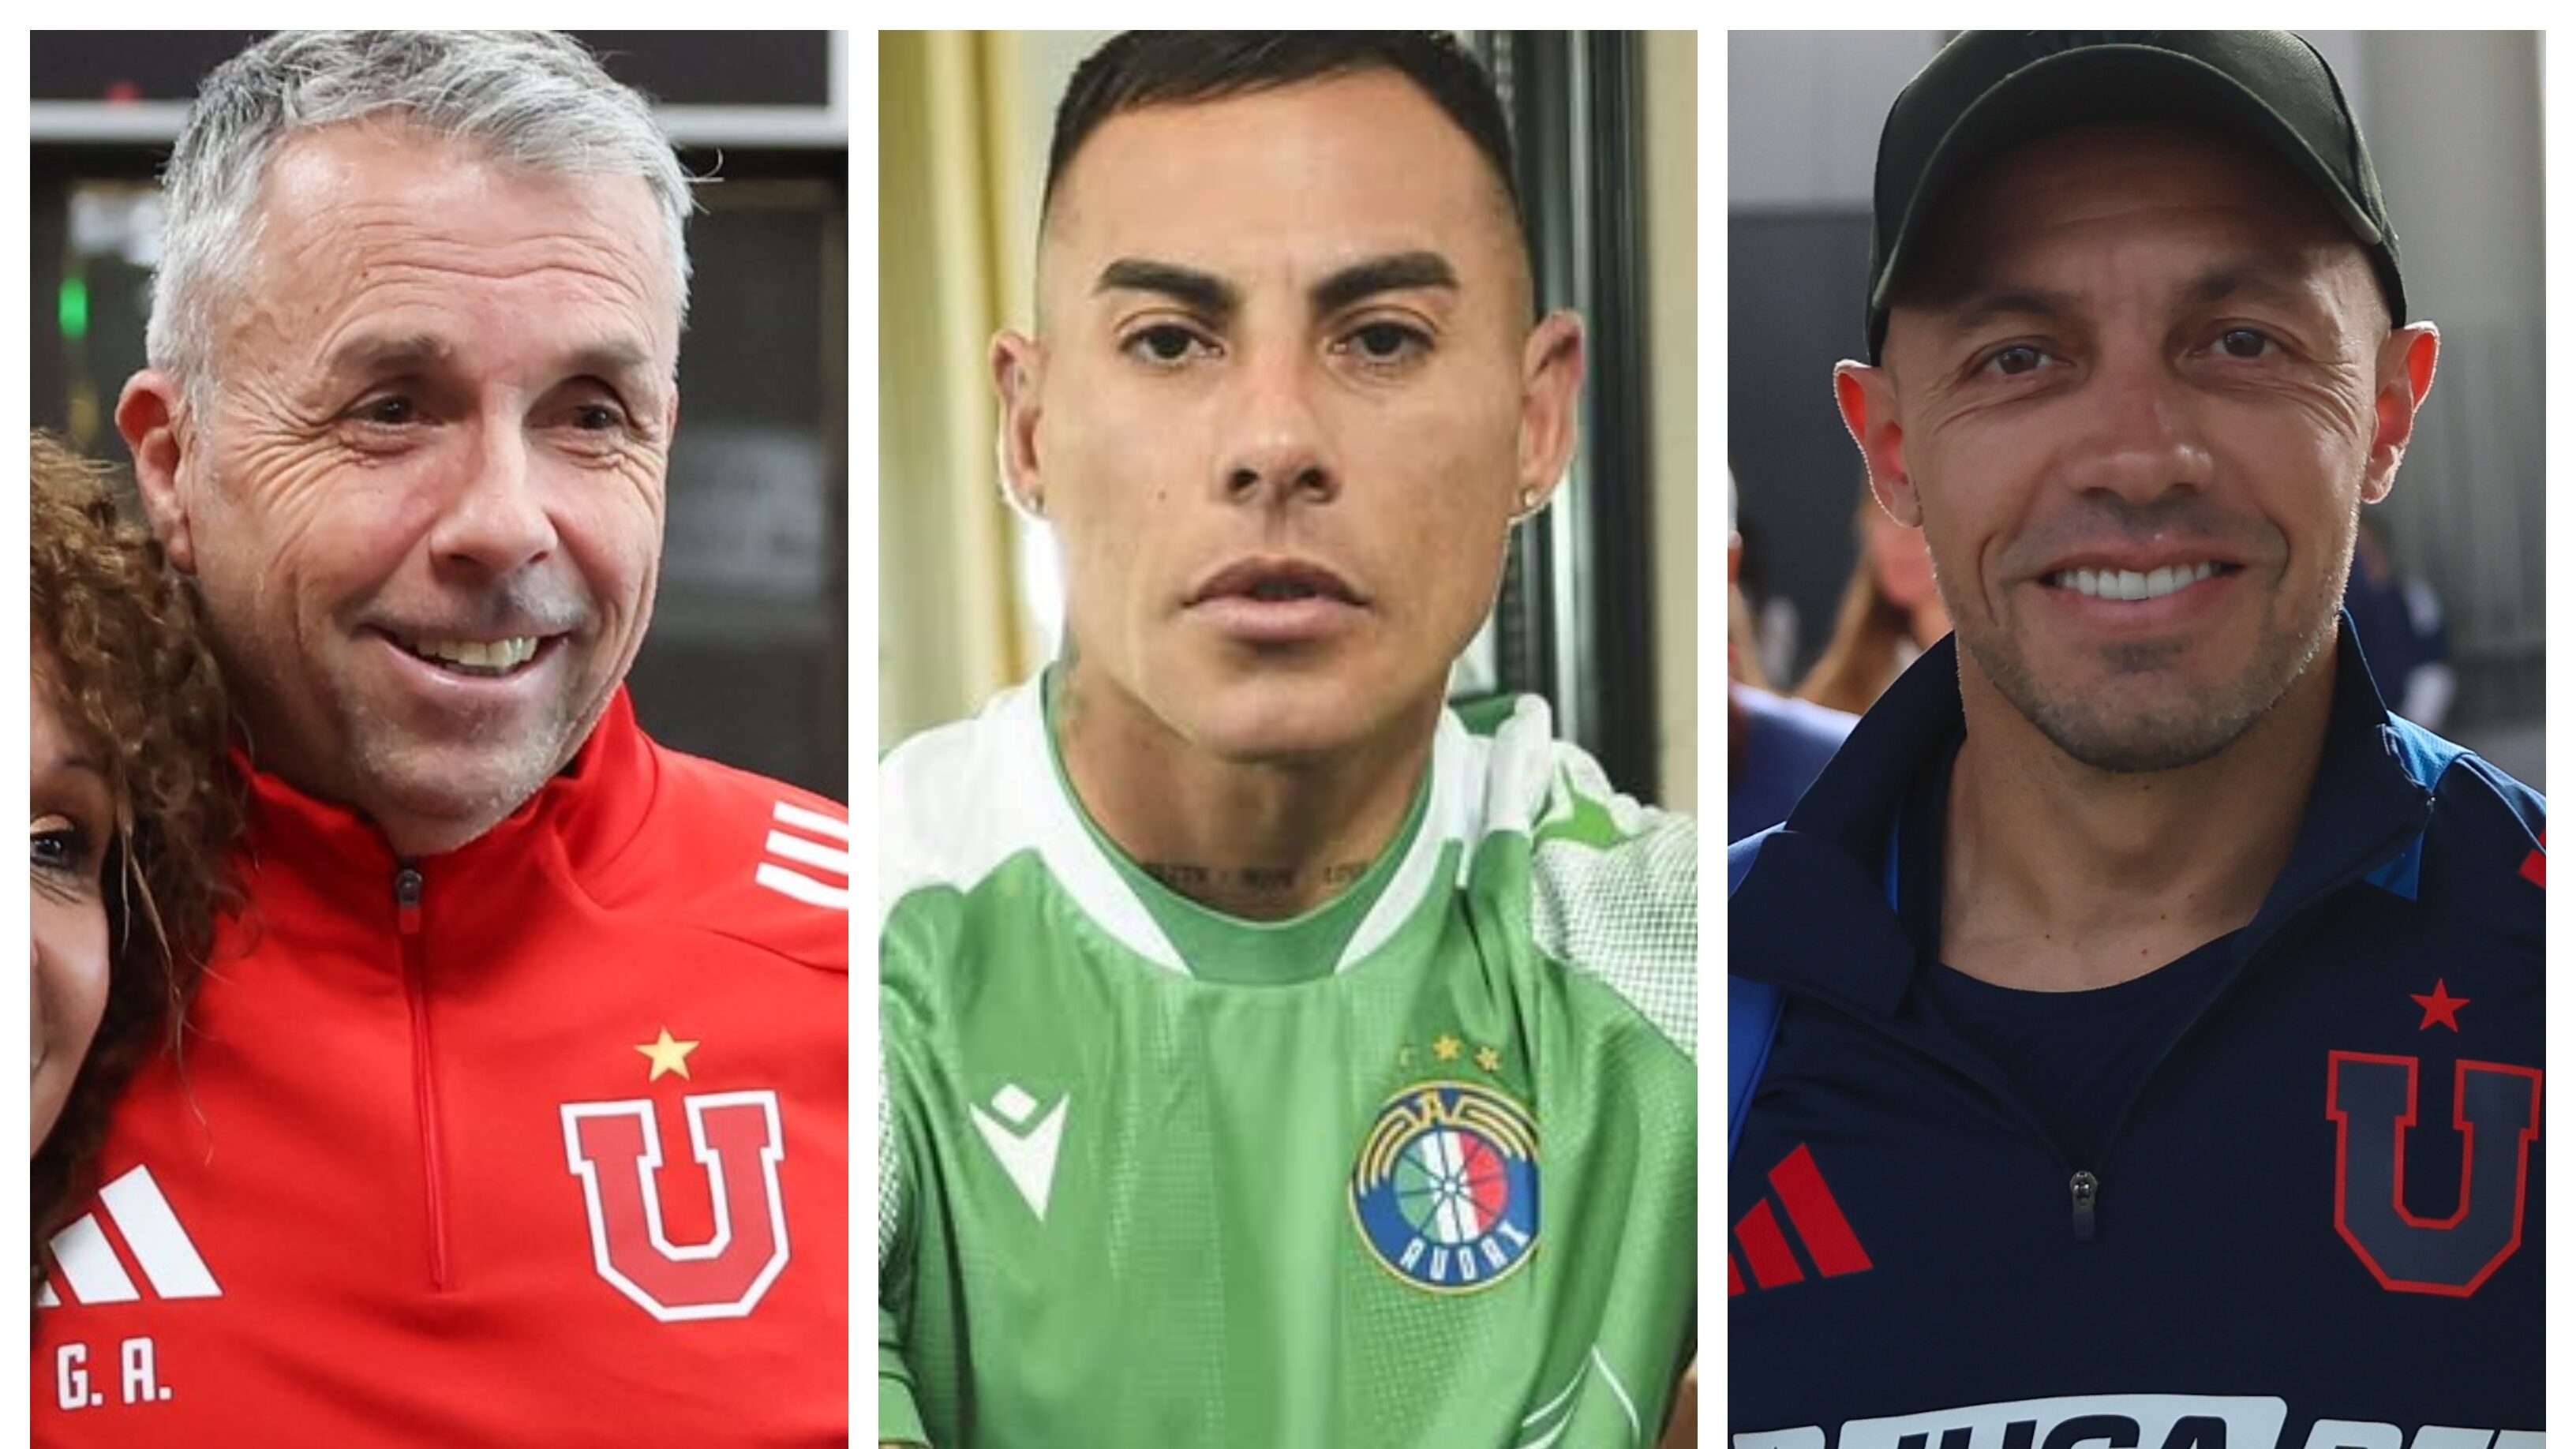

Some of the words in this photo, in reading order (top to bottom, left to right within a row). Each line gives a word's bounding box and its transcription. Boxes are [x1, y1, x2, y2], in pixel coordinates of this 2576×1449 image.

[560, 1090, 790, 1322] U
[2325, 1050, 2543, 1298] U
[57, 1342, 103, 1410] G.
[122, 1336, 172, 1405] A.
